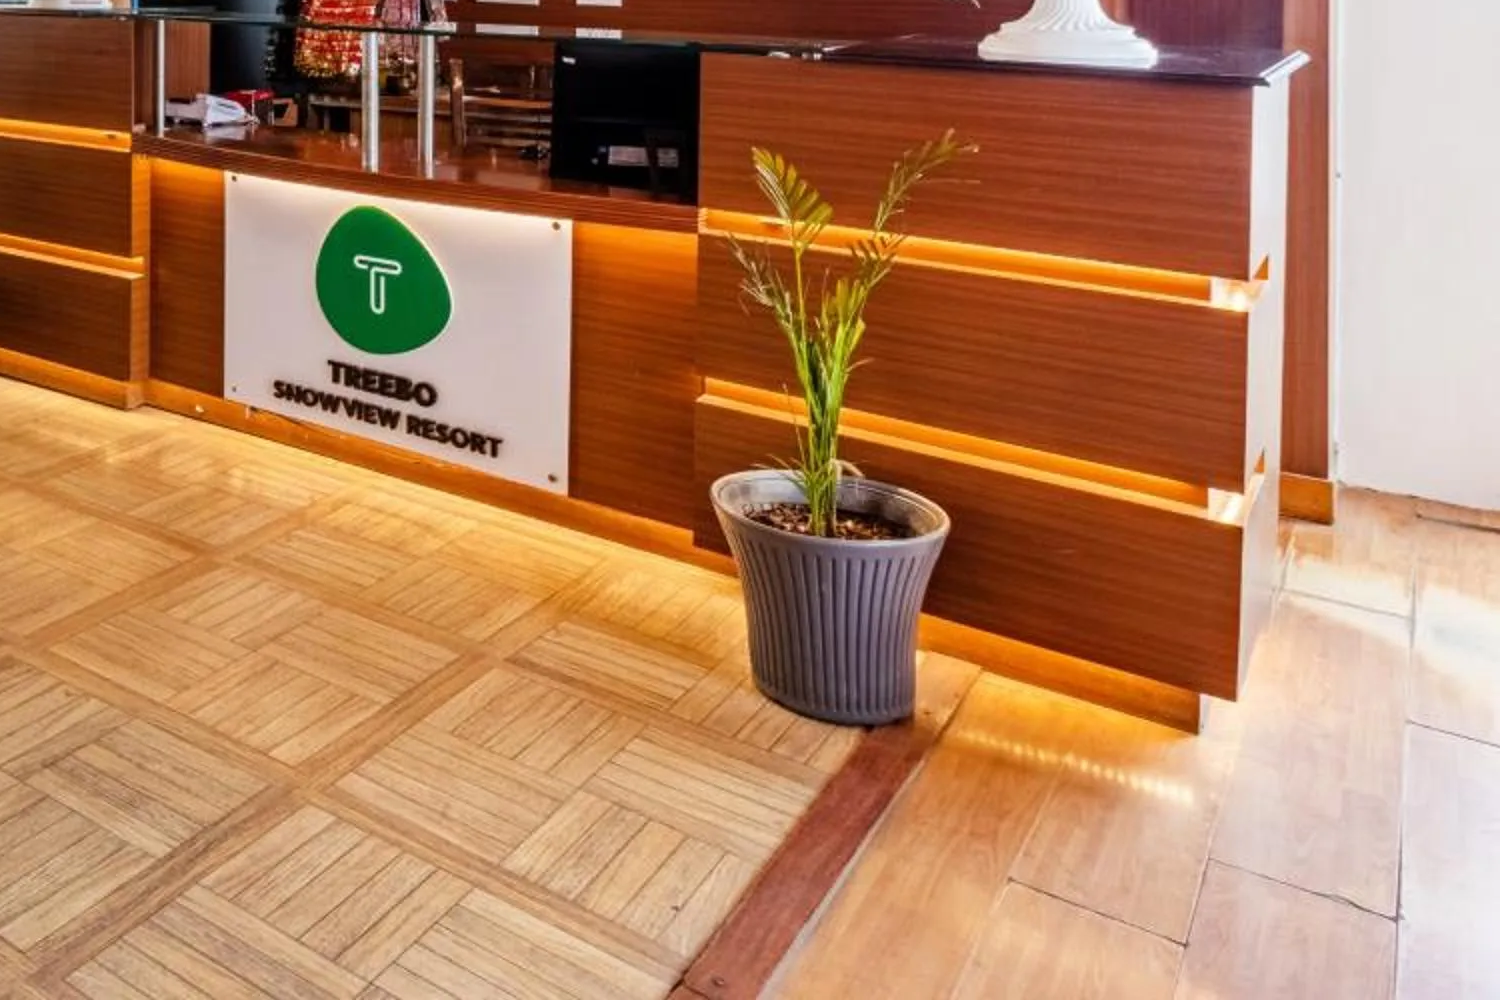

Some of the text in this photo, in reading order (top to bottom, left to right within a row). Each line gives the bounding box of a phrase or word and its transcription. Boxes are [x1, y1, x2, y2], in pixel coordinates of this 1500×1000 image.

[327, 359, 438, 407] TREEBO
[273, 379, 504, 458] SNOWVIEW RESORT
